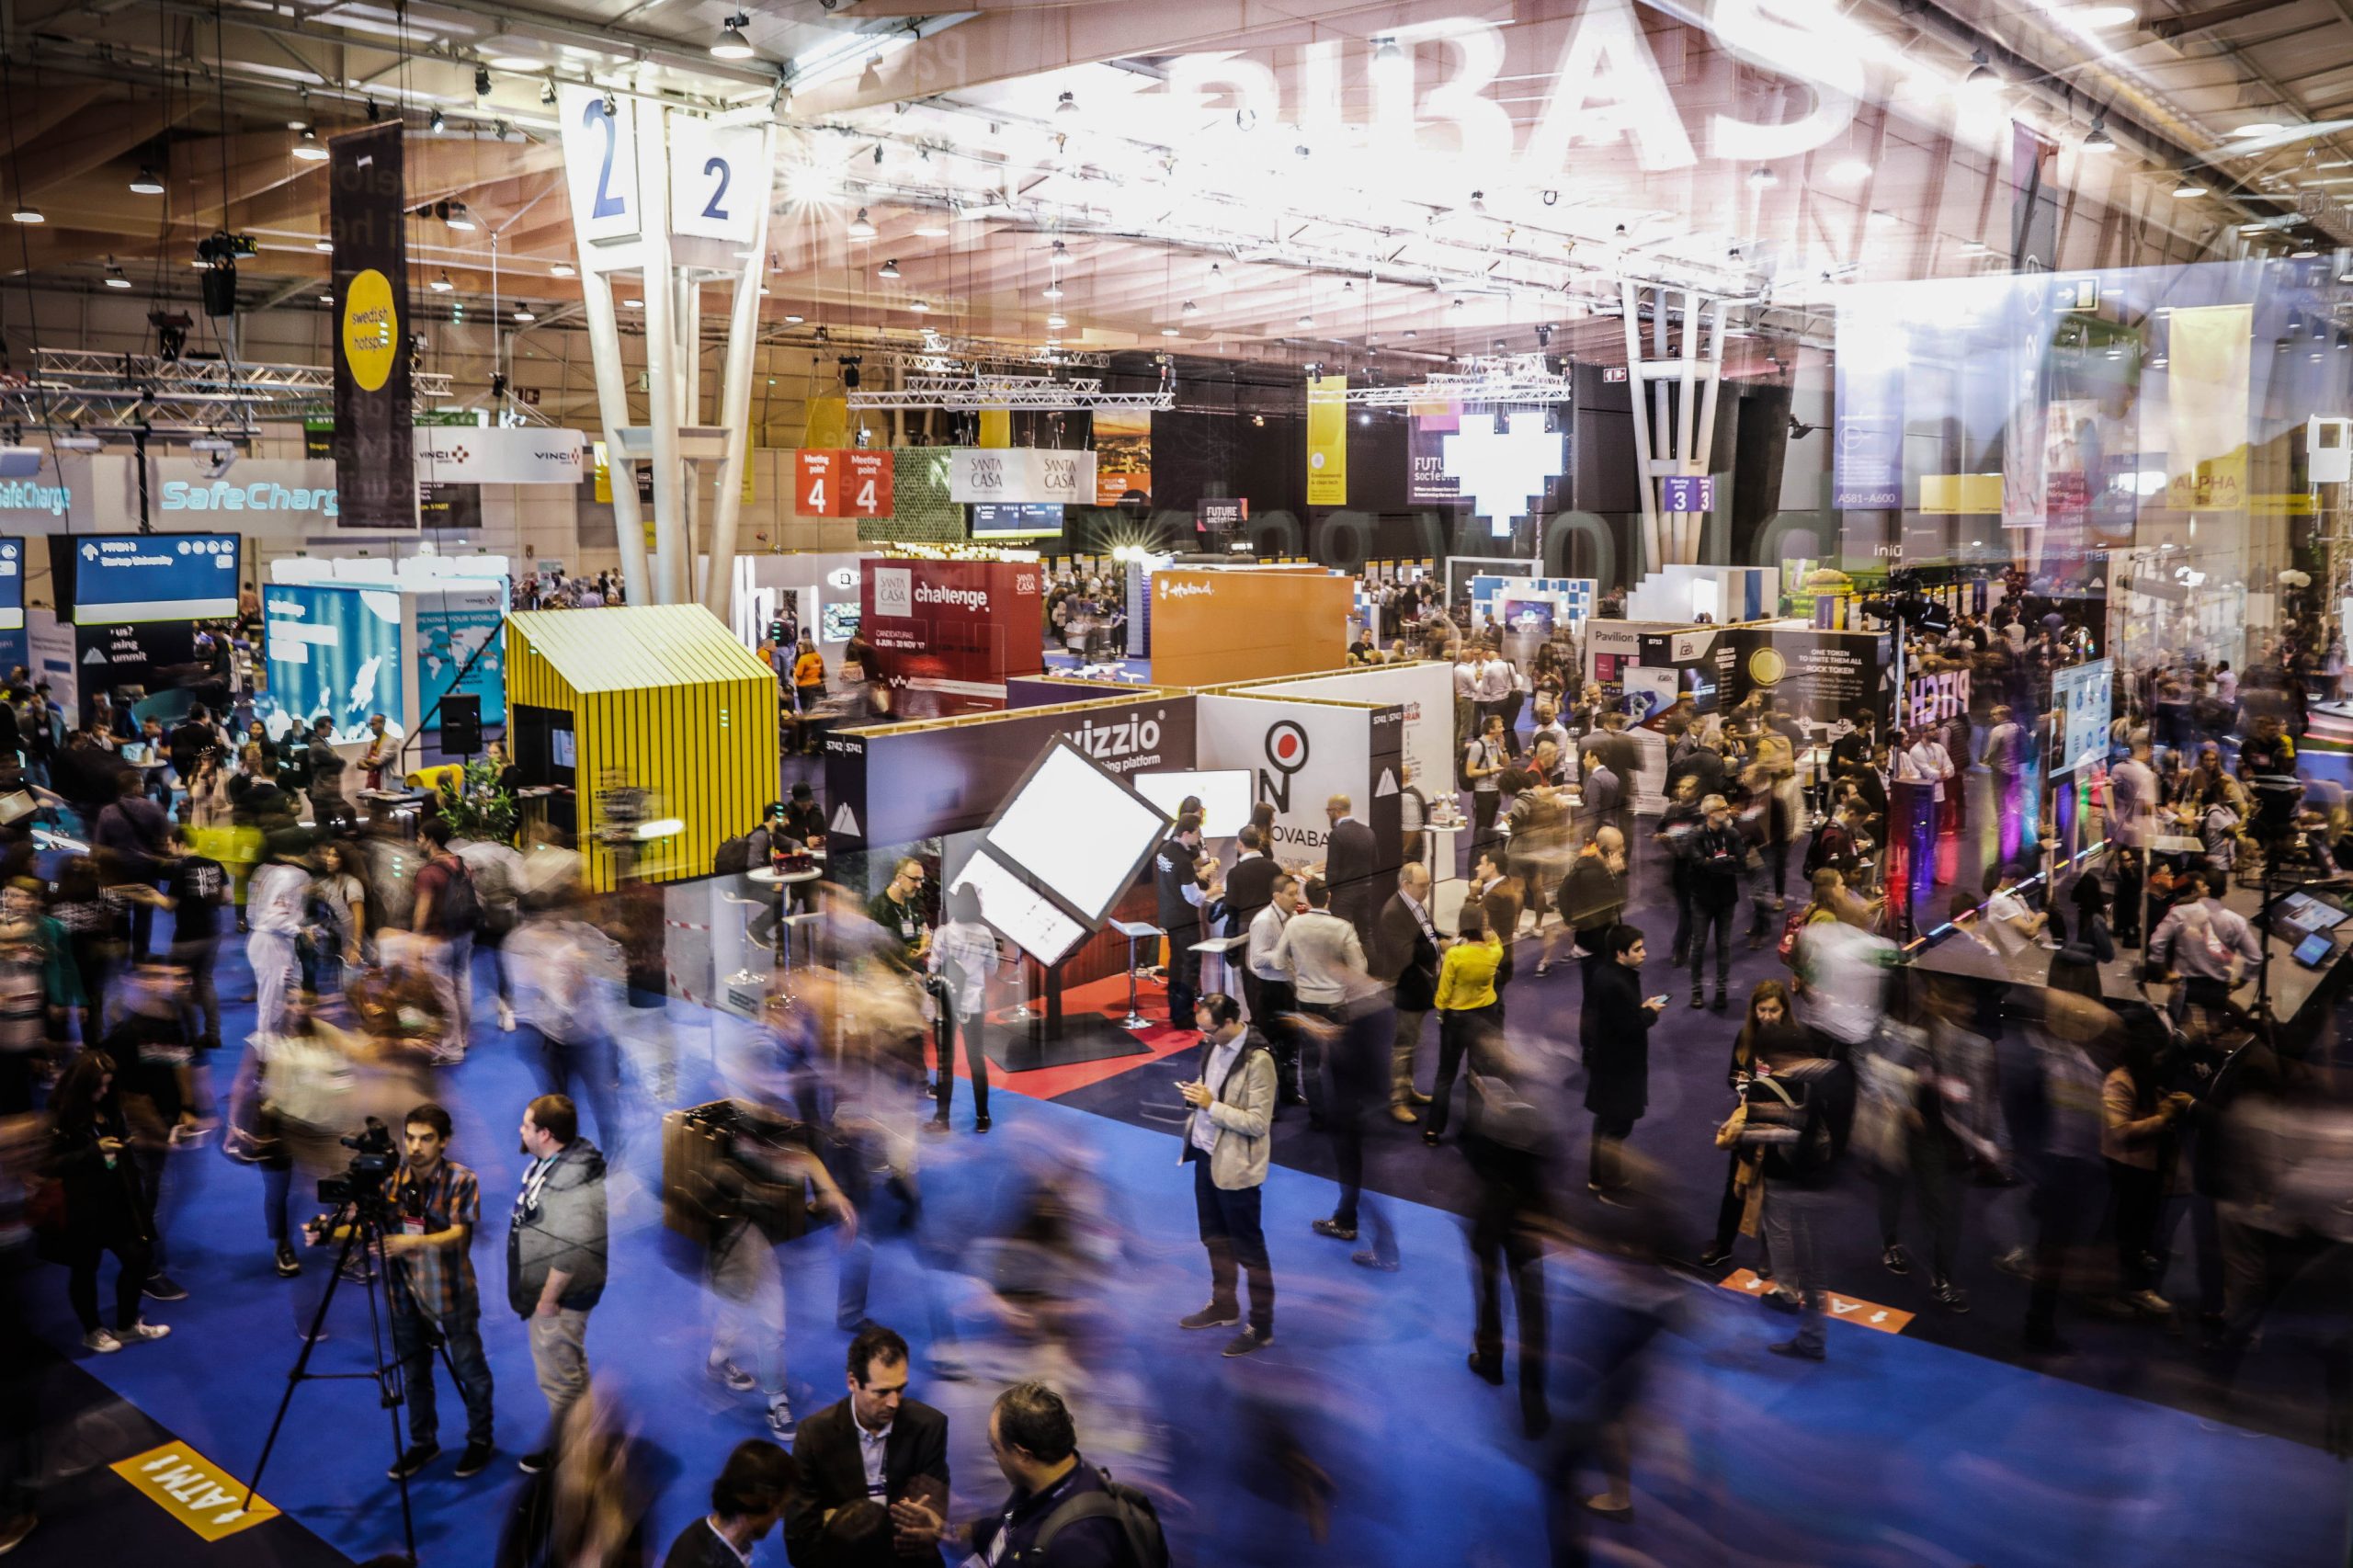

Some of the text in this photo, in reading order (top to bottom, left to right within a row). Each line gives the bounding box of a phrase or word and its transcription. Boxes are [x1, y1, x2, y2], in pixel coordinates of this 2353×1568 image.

[582, 98, 626, 220] 2
[702, 156, 731, 221] 2
[352, 306, 387, 325] swedish
[354, 335, 389, 353] hotspo
[419, 450, 449, 459] VINCI
[804, 454, 830, 466] Meeting
[851, 455, 882, 467] Meeting
[809, 464, 826, 475] point
[858, 466, 878, 475] point
[971, 458, 1003, 472] SANTA
[1044, 459, 1076, 472] SANTA
[971, 472, 1003, 488] CASA
[1044, 472, 1076, 489] CASA
[2174, 475, 2237, 491] ALPHA
[162, 481, 339, 517] SafeCharg
[808, 478, 826, 514] 4
[856, 479, 878, 514] 4
[1674, 491, 1687, 511] 3
[1700, 491, 1710, 511] 3
[1207, 506, 1237, 517] FUTURE
[881, 577, 905, 588] SANTA
[1017, 573, 1035, 582] SANTA
[1017, 581, 1035, 591] CASA
[881, 589, 905, 602] CASA
[915, 581, 988, 612] challenge
[417, 613, 499, 624] PENING YOUR WORLD
[1596, 631, 1633, 642] Pavilion
[111, 651, 147, 663] ummit
[1809, 655, 1829, 664] UNITE
[1830, 656, 1849, 665] THEM
[1805, 665, 1855, 675] ROCK TOKEN
[1122, 754, 1161, 771] platform
[1271, 825, 1329, 847] OVABA
[151, 1464, 238, 1510] ATM
